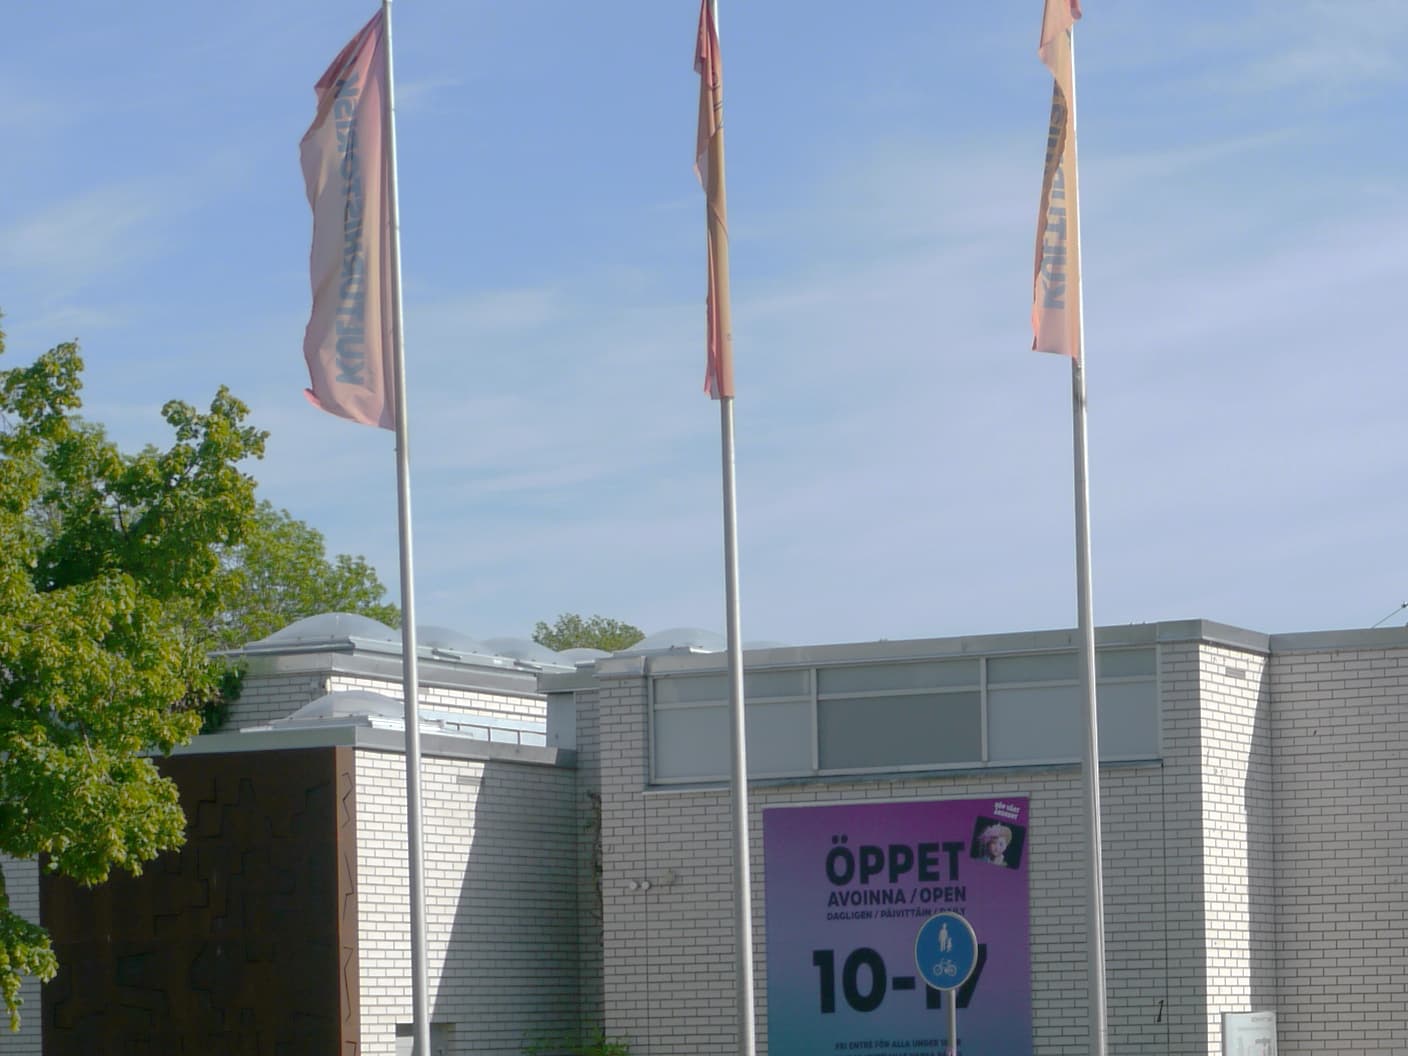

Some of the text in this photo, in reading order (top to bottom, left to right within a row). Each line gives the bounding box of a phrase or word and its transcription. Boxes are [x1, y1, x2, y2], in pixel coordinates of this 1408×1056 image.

[826, 835, 965, 886] ÖPPET
[827, 889, 906, 907] AVOINNA
[919, 886, 967, 903] OPEN
[827, 910, 872, 921] DAGLIGEN
